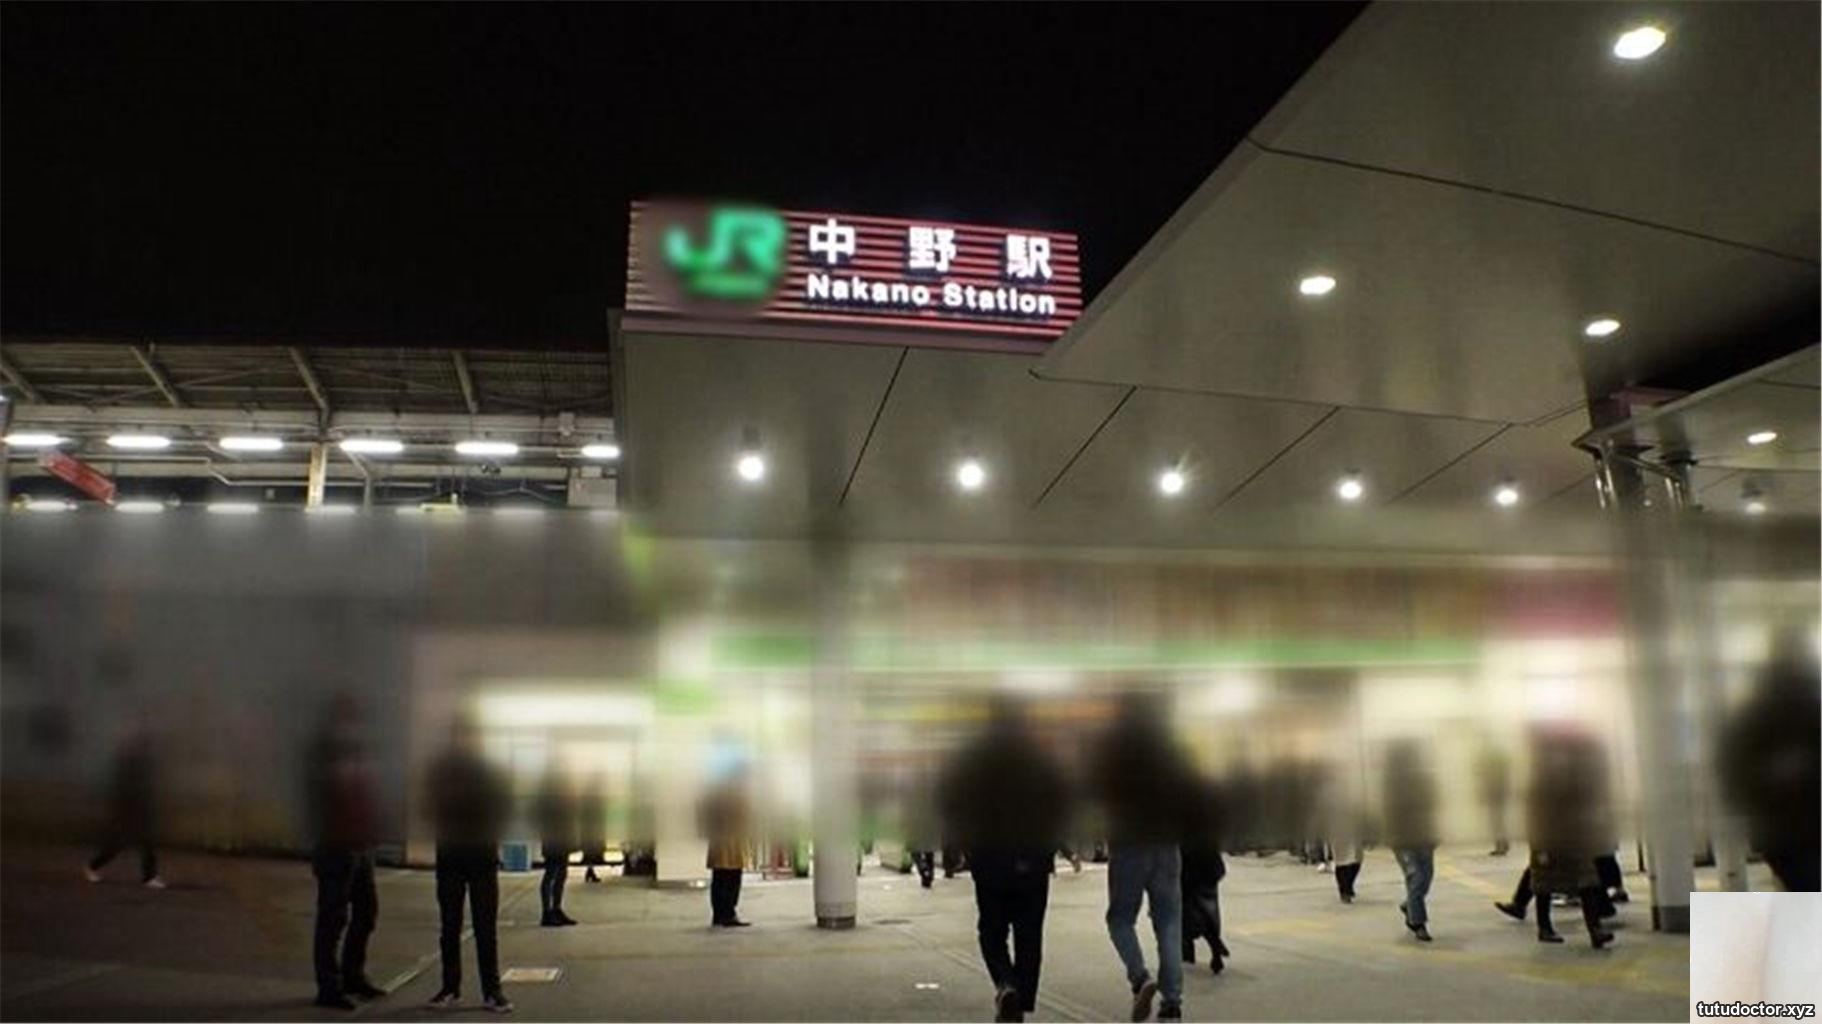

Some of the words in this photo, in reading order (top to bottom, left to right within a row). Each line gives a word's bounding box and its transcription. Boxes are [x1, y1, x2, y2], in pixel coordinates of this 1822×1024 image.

[662, 207, 785, 272] JR
[809, 218, 1053, 280] 中野駅
[807, 273, 930, 306] Nakano
[943, 282, 1056, 315] Station
